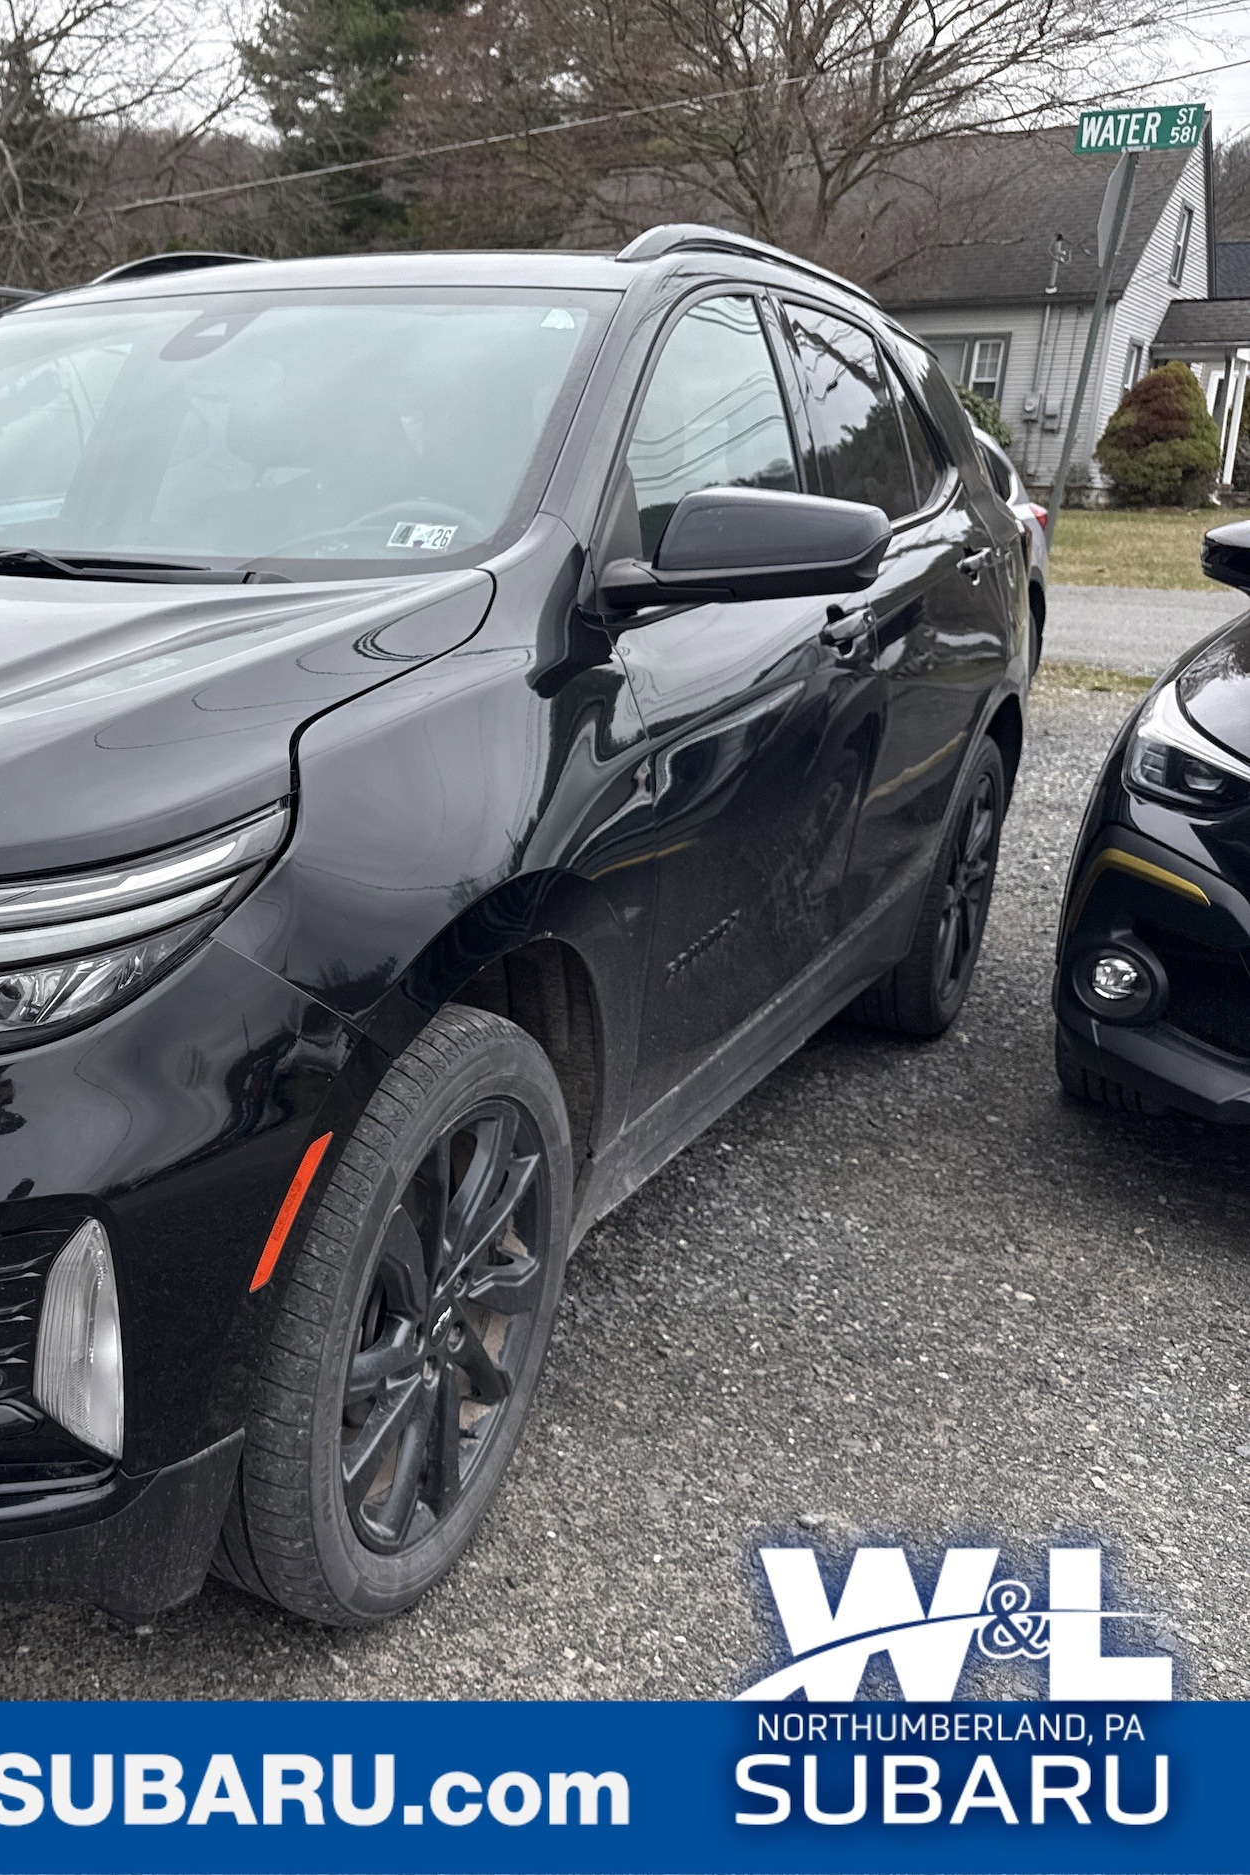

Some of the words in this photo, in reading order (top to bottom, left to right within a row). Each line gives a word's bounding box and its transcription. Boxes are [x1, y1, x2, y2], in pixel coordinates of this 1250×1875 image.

[1081, 111, 1162, 148] WATER
[1176, 107, 1198, 125] ST
[1169, 125, 1197, 145] 581
[432, 528, 452, 547] 26
